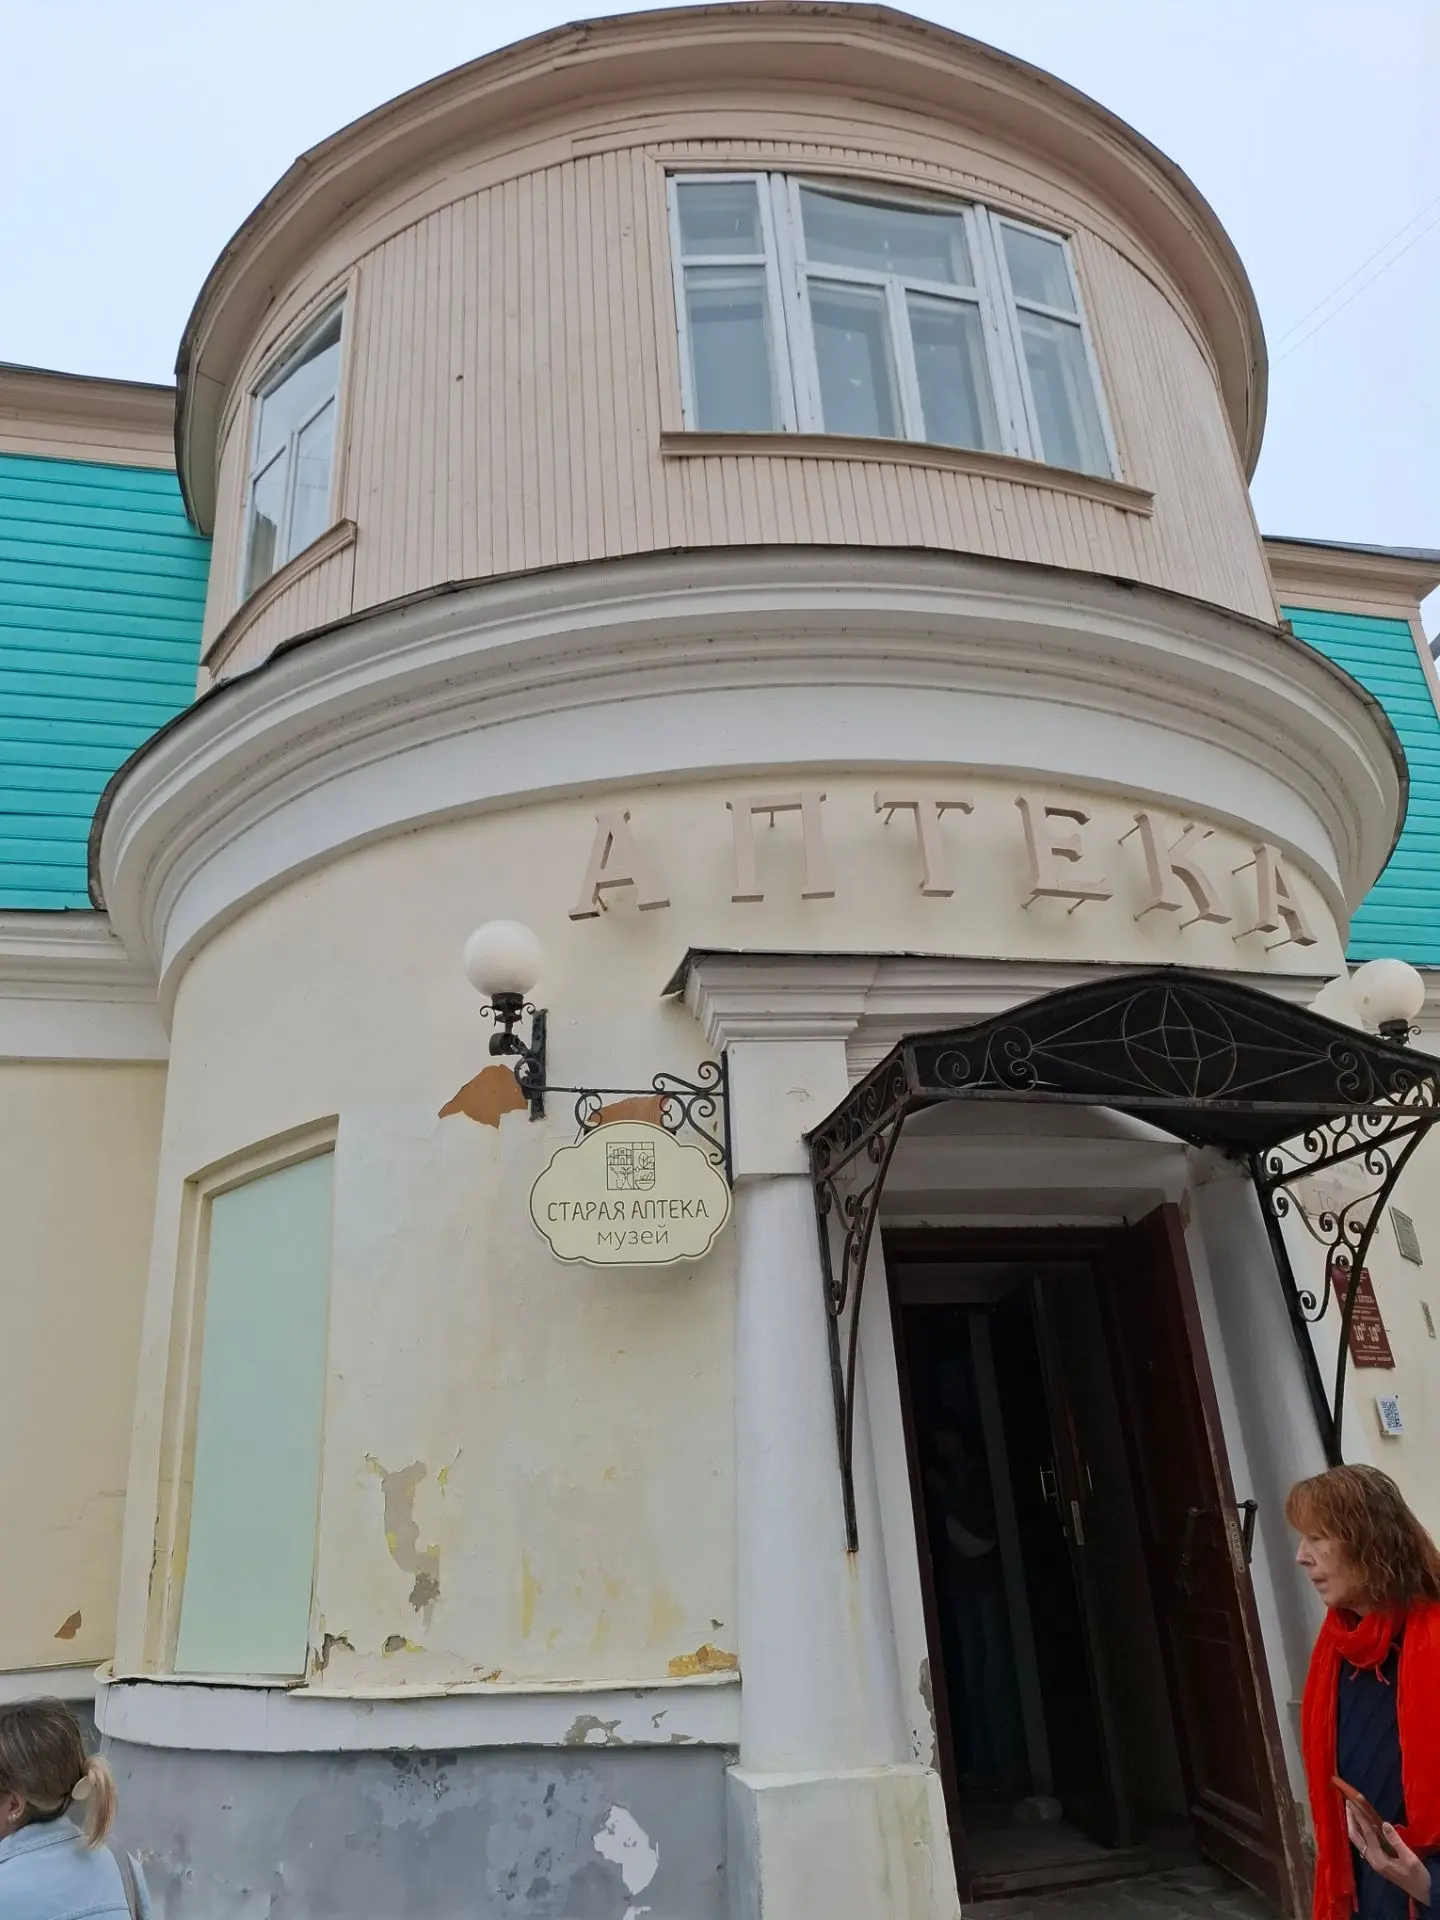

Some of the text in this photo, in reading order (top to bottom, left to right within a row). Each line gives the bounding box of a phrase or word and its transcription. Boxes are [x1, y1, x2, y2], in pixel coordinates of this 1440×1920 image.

[568, 790, 1318, 947] АПТЕКА
[547, 1199, 709, 1221] СТАРАЯ АПТЕКА
[597, 1224, 669, 1250] музей
